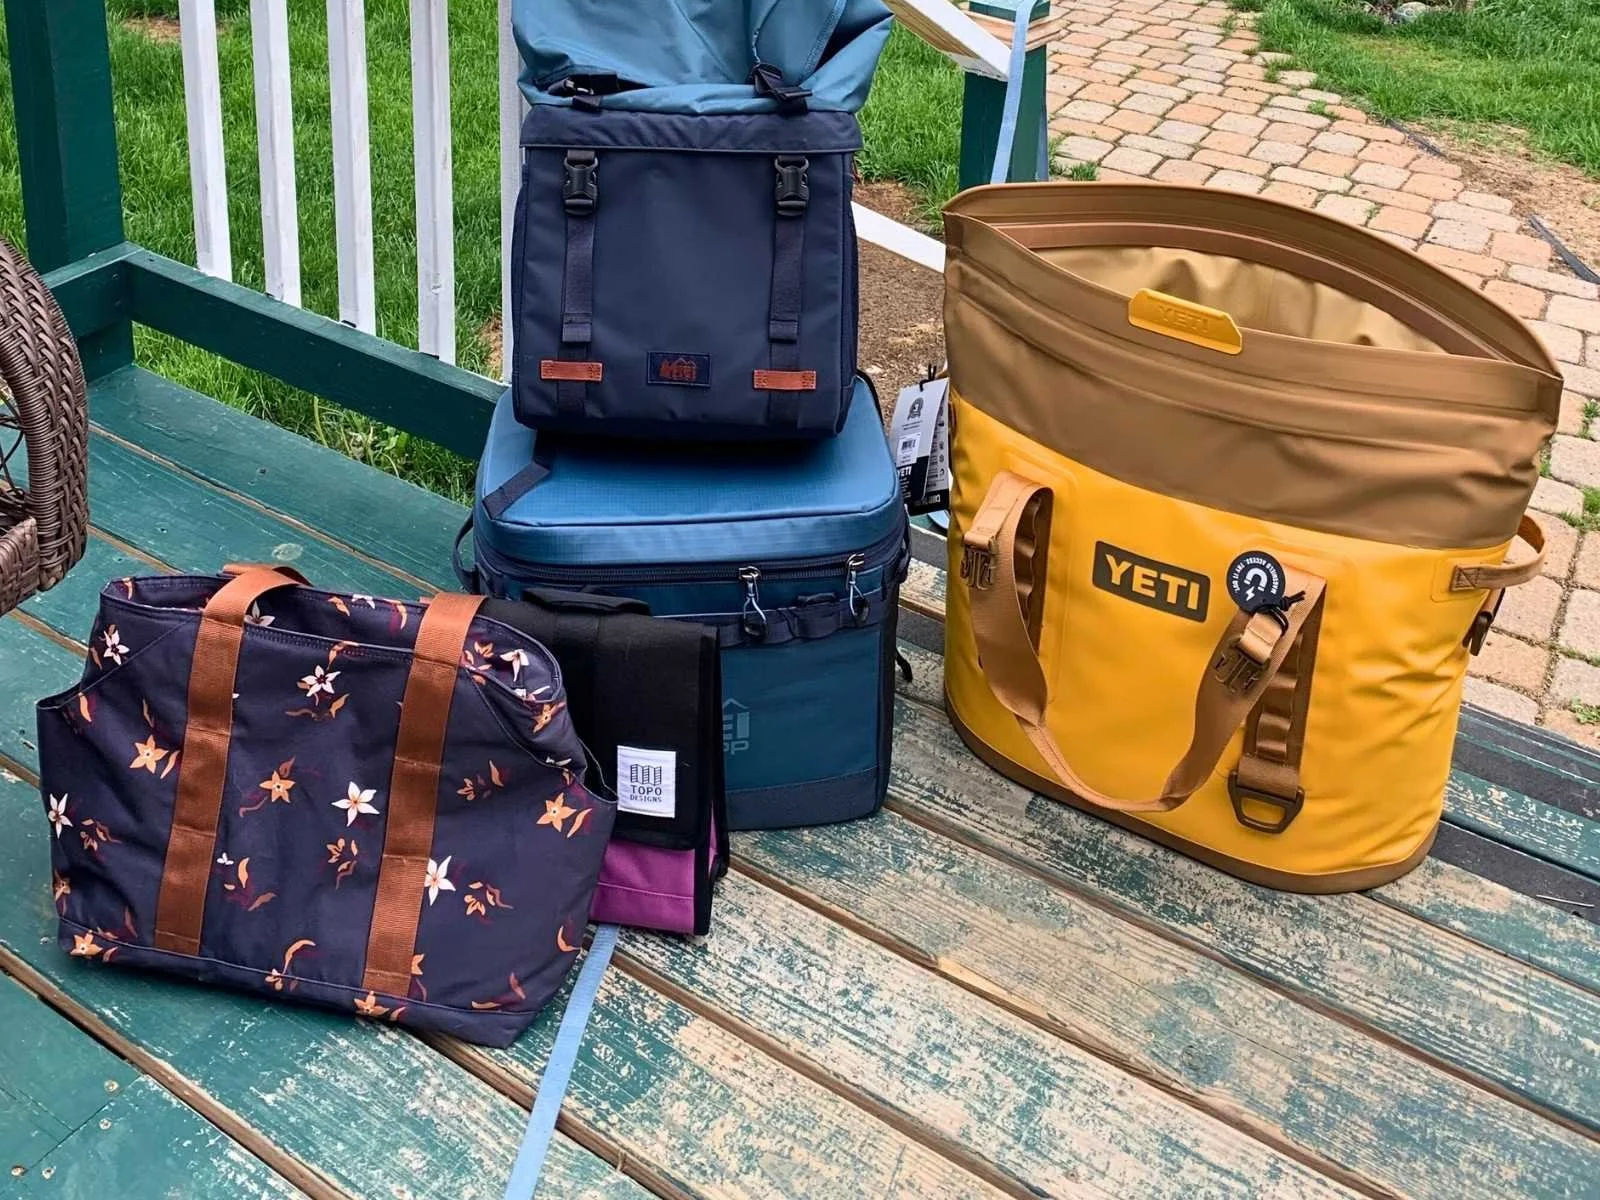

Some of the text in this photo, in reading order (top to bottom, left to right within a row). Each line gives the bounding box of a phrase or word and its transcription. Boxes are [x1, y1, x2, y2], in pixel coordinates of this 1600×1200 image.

[1158, 305, 1209, 334] YETI
[1105, 553, 1200, 610] YETI
[630, 785, 662, 796] TOPO
[630, 794, 662, 803] DESIGNS
